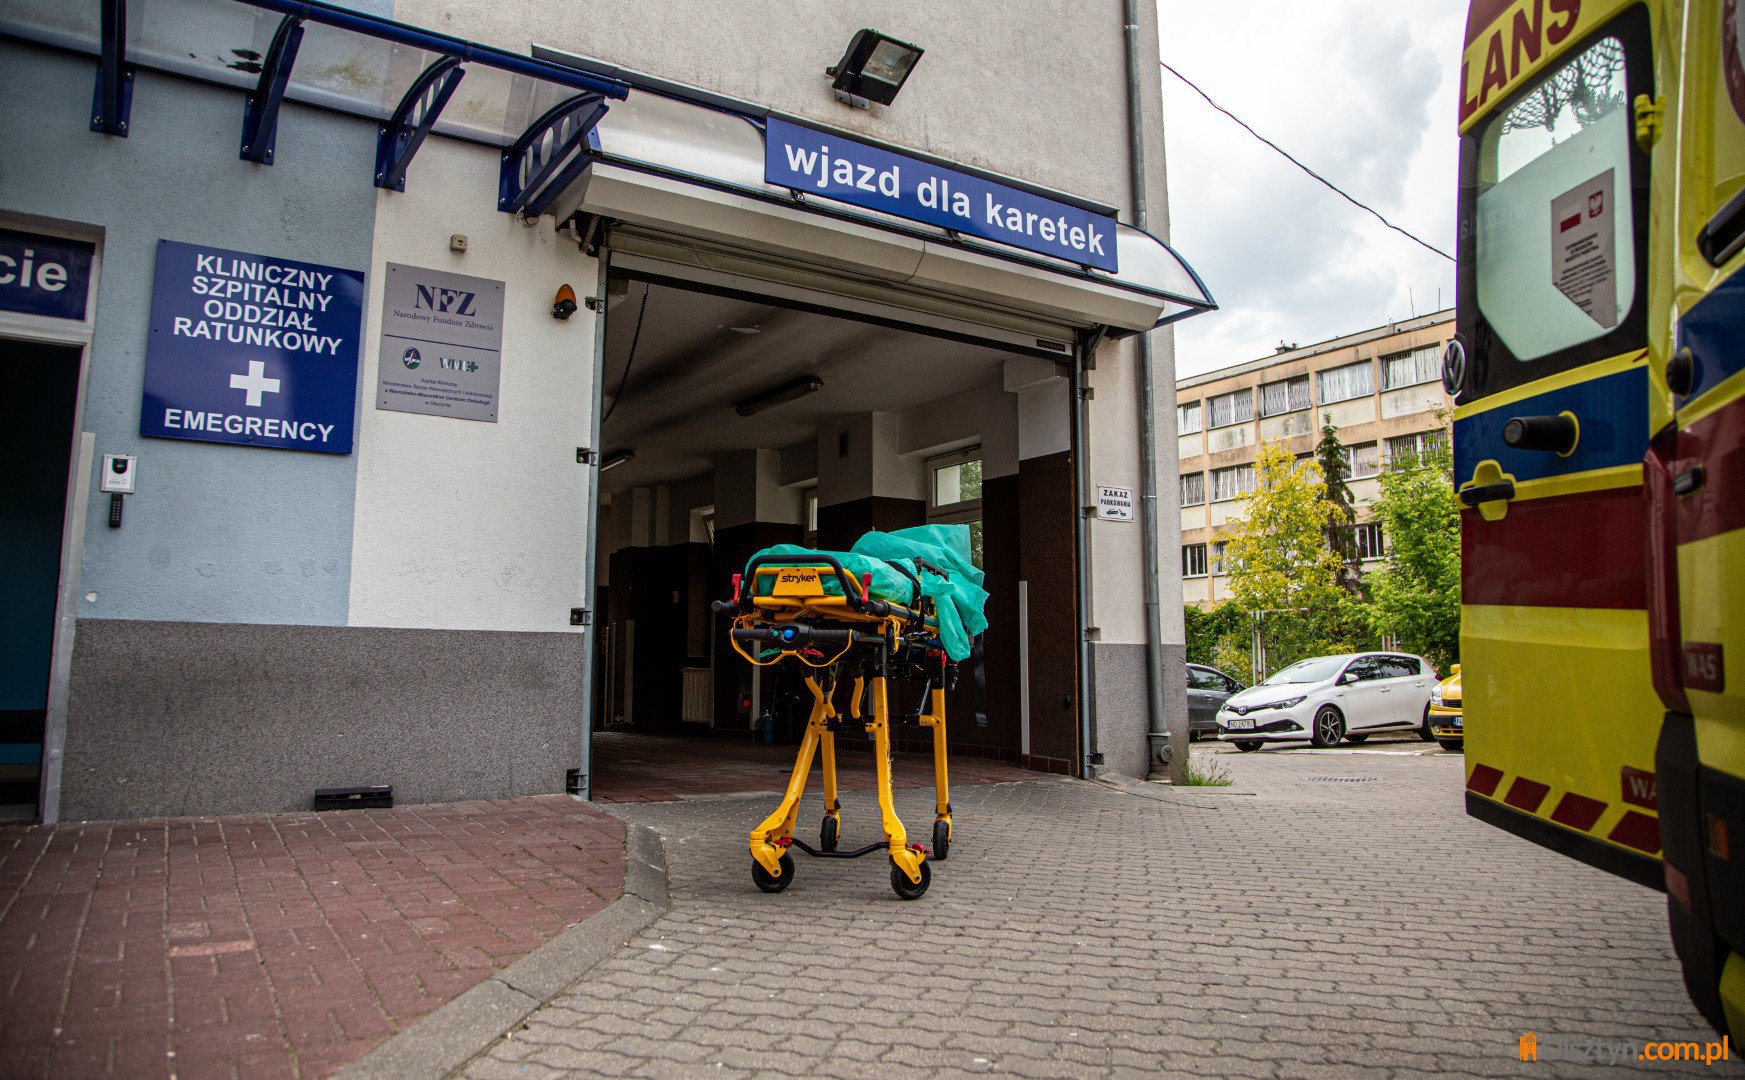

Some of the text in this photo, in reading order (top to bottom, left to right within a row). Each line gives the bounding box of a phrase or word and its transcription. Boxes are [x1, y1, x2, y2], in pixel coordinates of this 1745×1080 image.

[784, 143, 1106, 257] wjazd dla karetek
[196, 253, 333, 292] KLINICZNY
[191, 276, 333, 312] SZPITALNY
[414, 283, 477, 317] NFZ
[203, 299, 318, 332] ODDZIAŁ
[393, 309, 494, 331] Narodowy Fundusz Zdrowia
[173, 316, 343, 356] RATUNKOWY
[163, 407, 335, 443] EMEGRENCY
[1103, 489, 1128, 498] ZAKAZ
[781, 573, 817, 584] stryker
